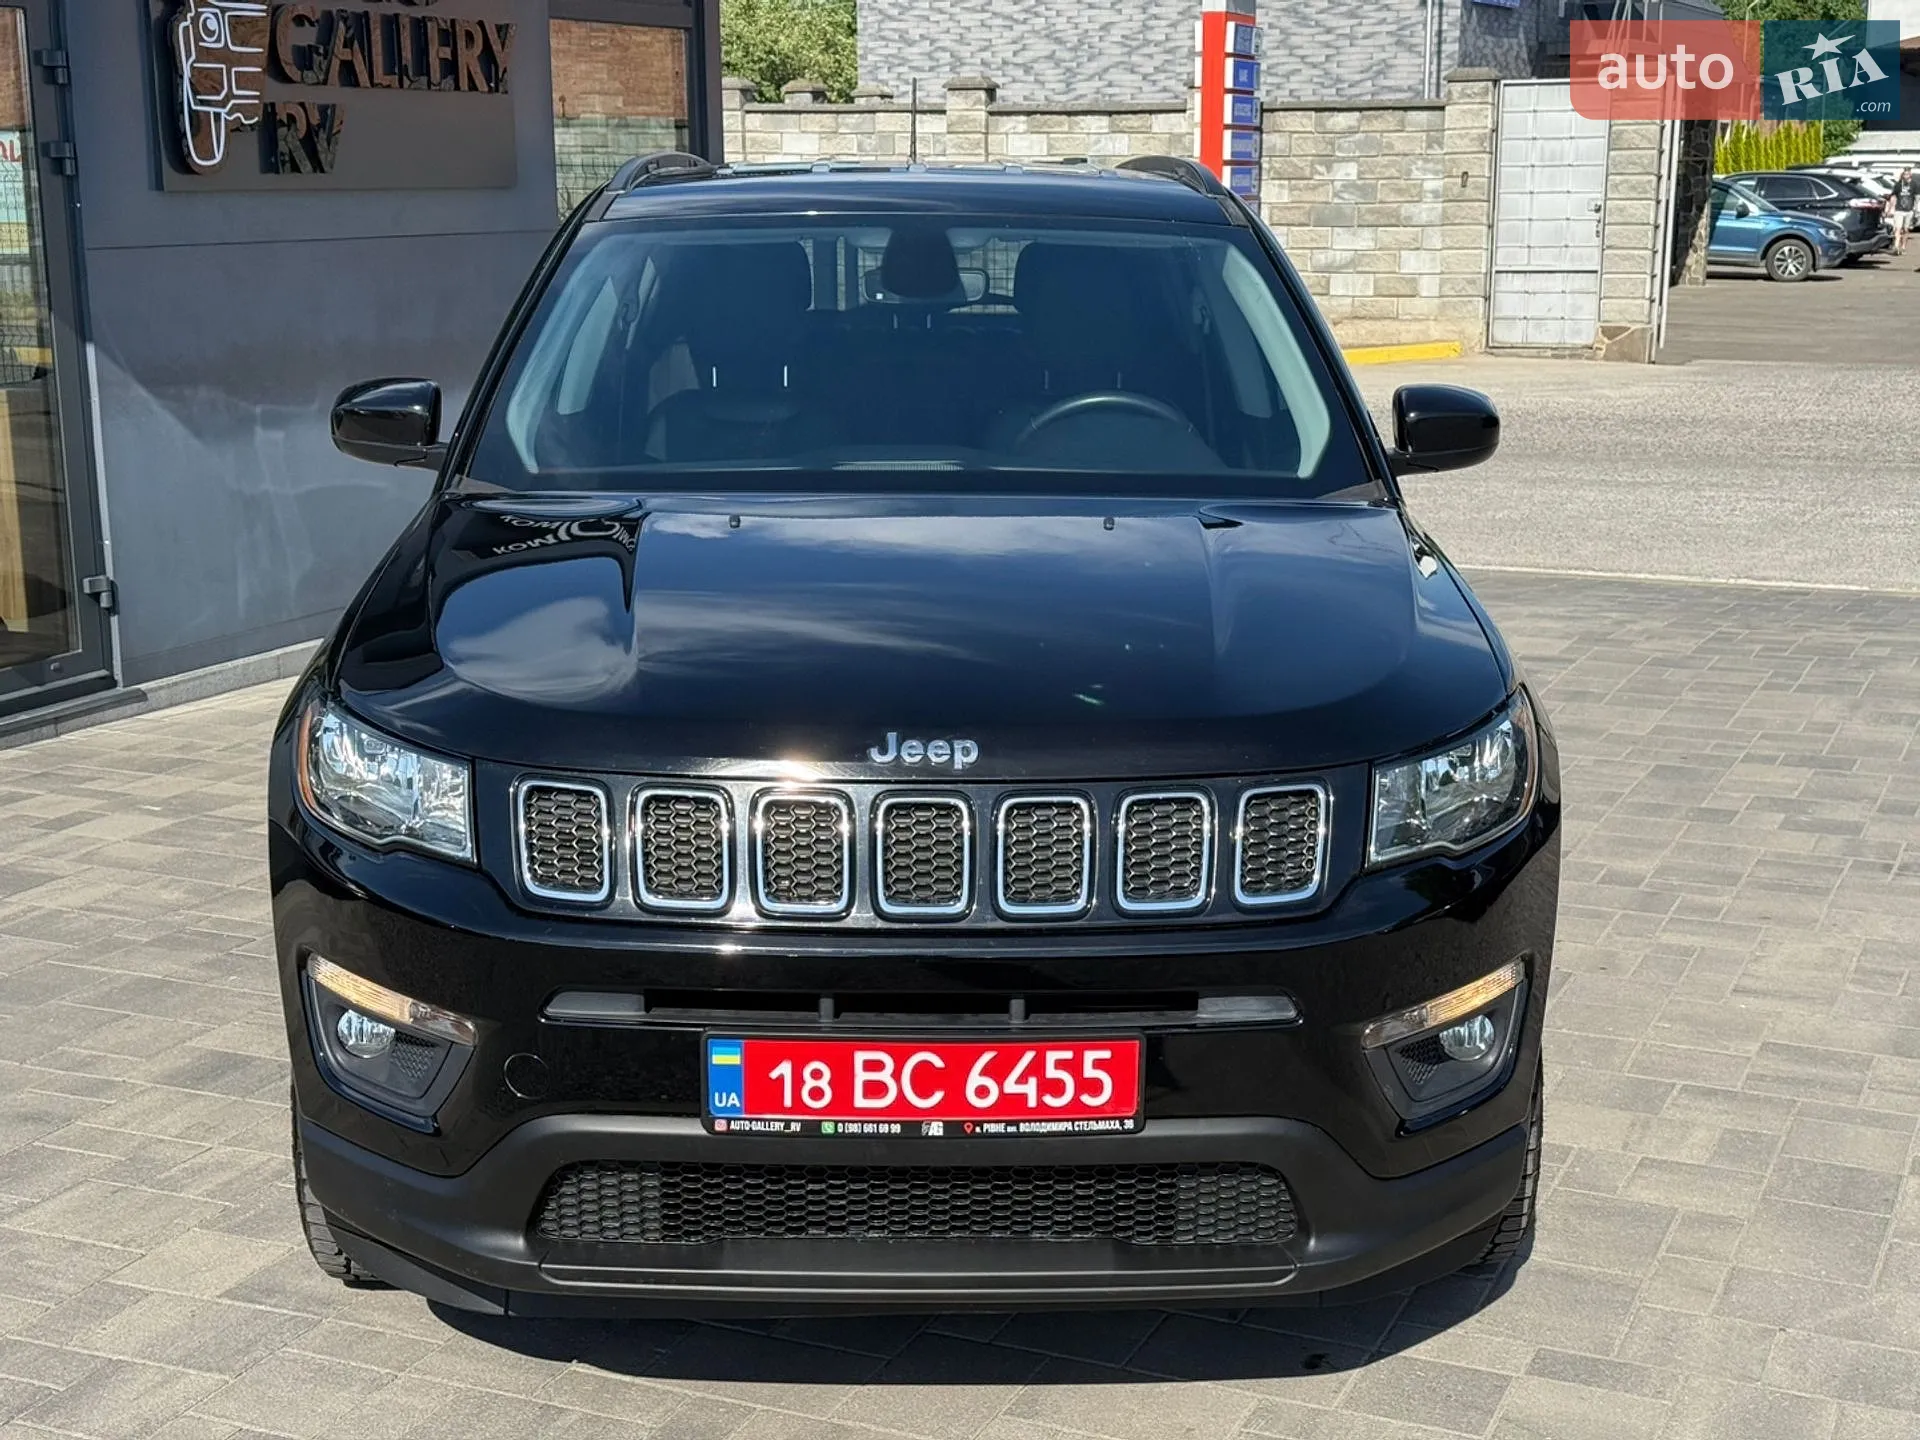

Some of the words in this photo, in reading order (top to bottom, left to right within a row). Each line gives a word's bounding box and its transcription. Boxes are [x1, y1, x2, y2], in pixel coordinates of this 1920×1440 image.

[276, 4, 517, 94] GALLERY
[274, 102, 346, 174] RV
[868, 732, 979, 770] Jeep
[714, 1092, 740, 1107] UA
[768, 1059, 832, 1109] 18
[853, 1050, 946, 1109] BC
[965, 1050, 1113, 1108] 6455
